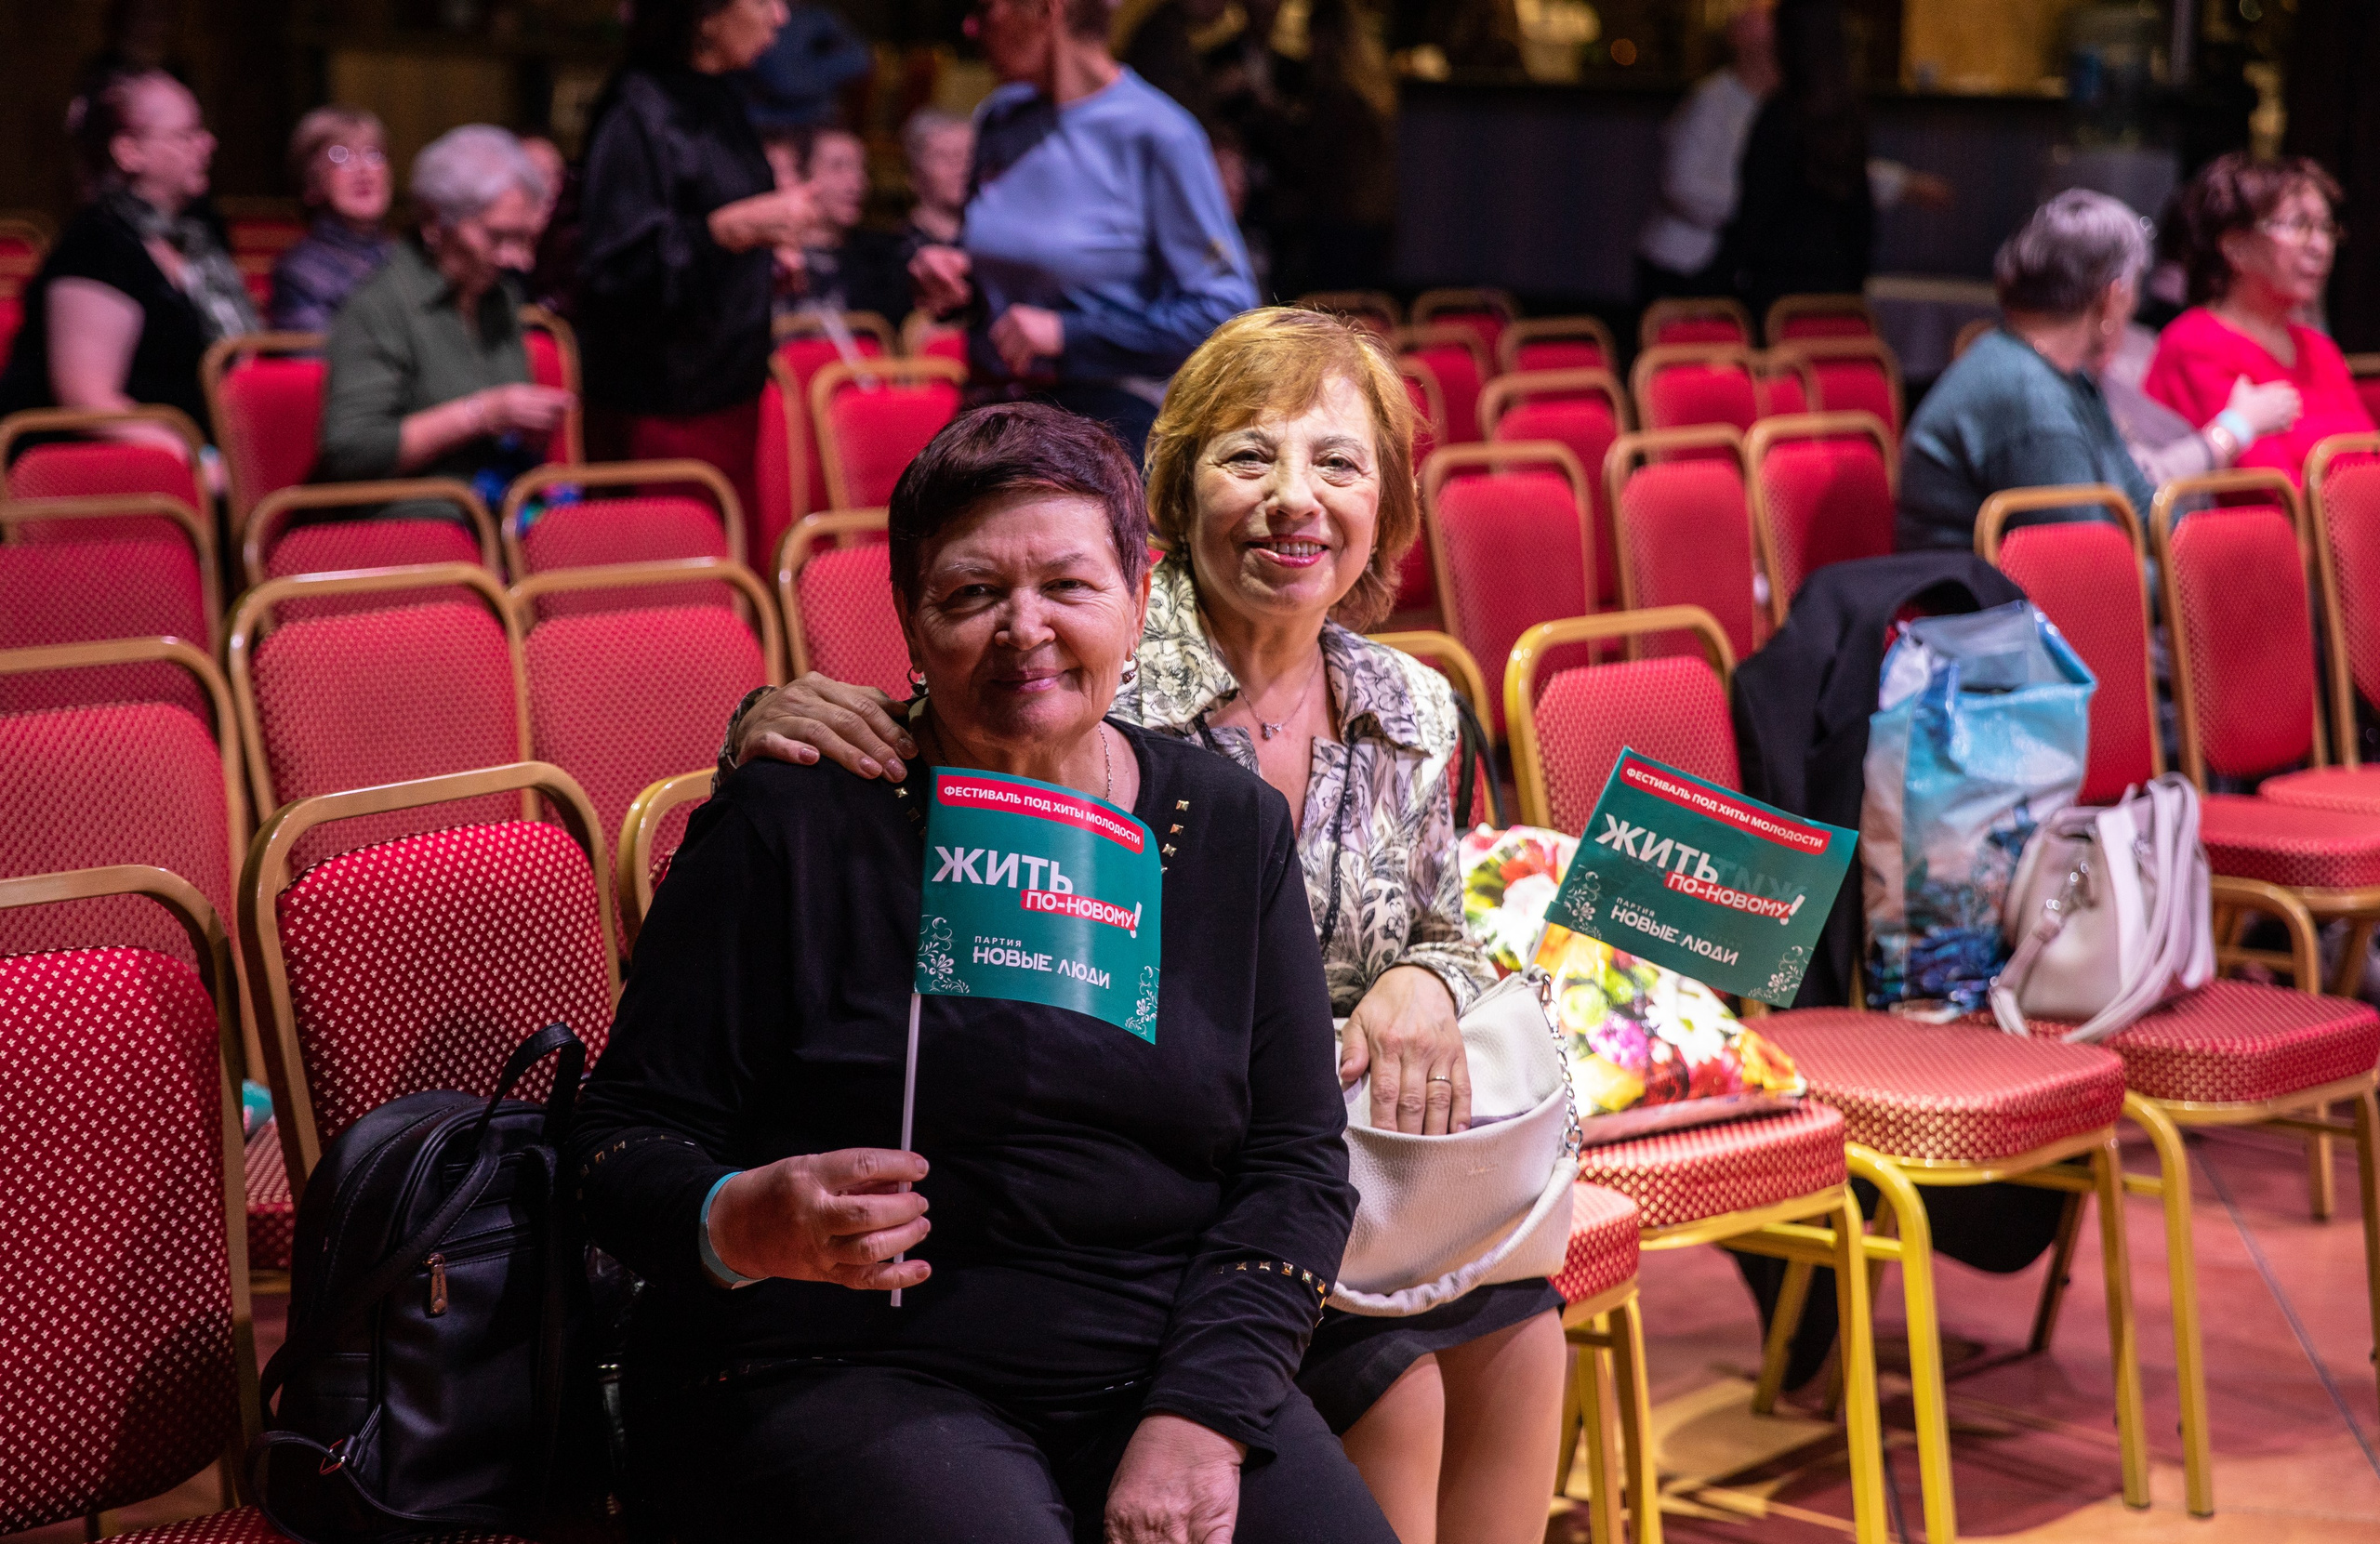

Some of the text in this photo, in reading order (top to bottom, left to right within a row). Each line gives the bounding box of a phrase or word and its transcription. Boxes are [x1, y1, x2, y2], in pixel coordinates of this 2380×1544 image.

[944, 785, 1140, 845] ФЕСТИВАЛЬ ПОД ХИТЫ МОЛОДОСТИ
[1627, 768, 1824, 848] ФЕСТИВАЛЬ ПОД ХИТЫ МОЛОДОСТИ
[931, 846, 1074, 895] ЖИТЬ
[1594, 813, 1718, 885] ЖИТЬ
[1025, 891, 1143, 939] ПО-НОВОМУ!
[1616, 896, 1655, 917] ПАРТИЯ
[1667, 872, 1805, 926] ПО-НОВОМУ!
[974, 935, 1022, 947] ПАРТИЯ
[1610, 904, 1679, 944] НОВЫЕ
[1679, 934, 1739, 966] ЛЮДИ
[972, 945, 1110, 989] НОВЫЕ ЛЮДИ
